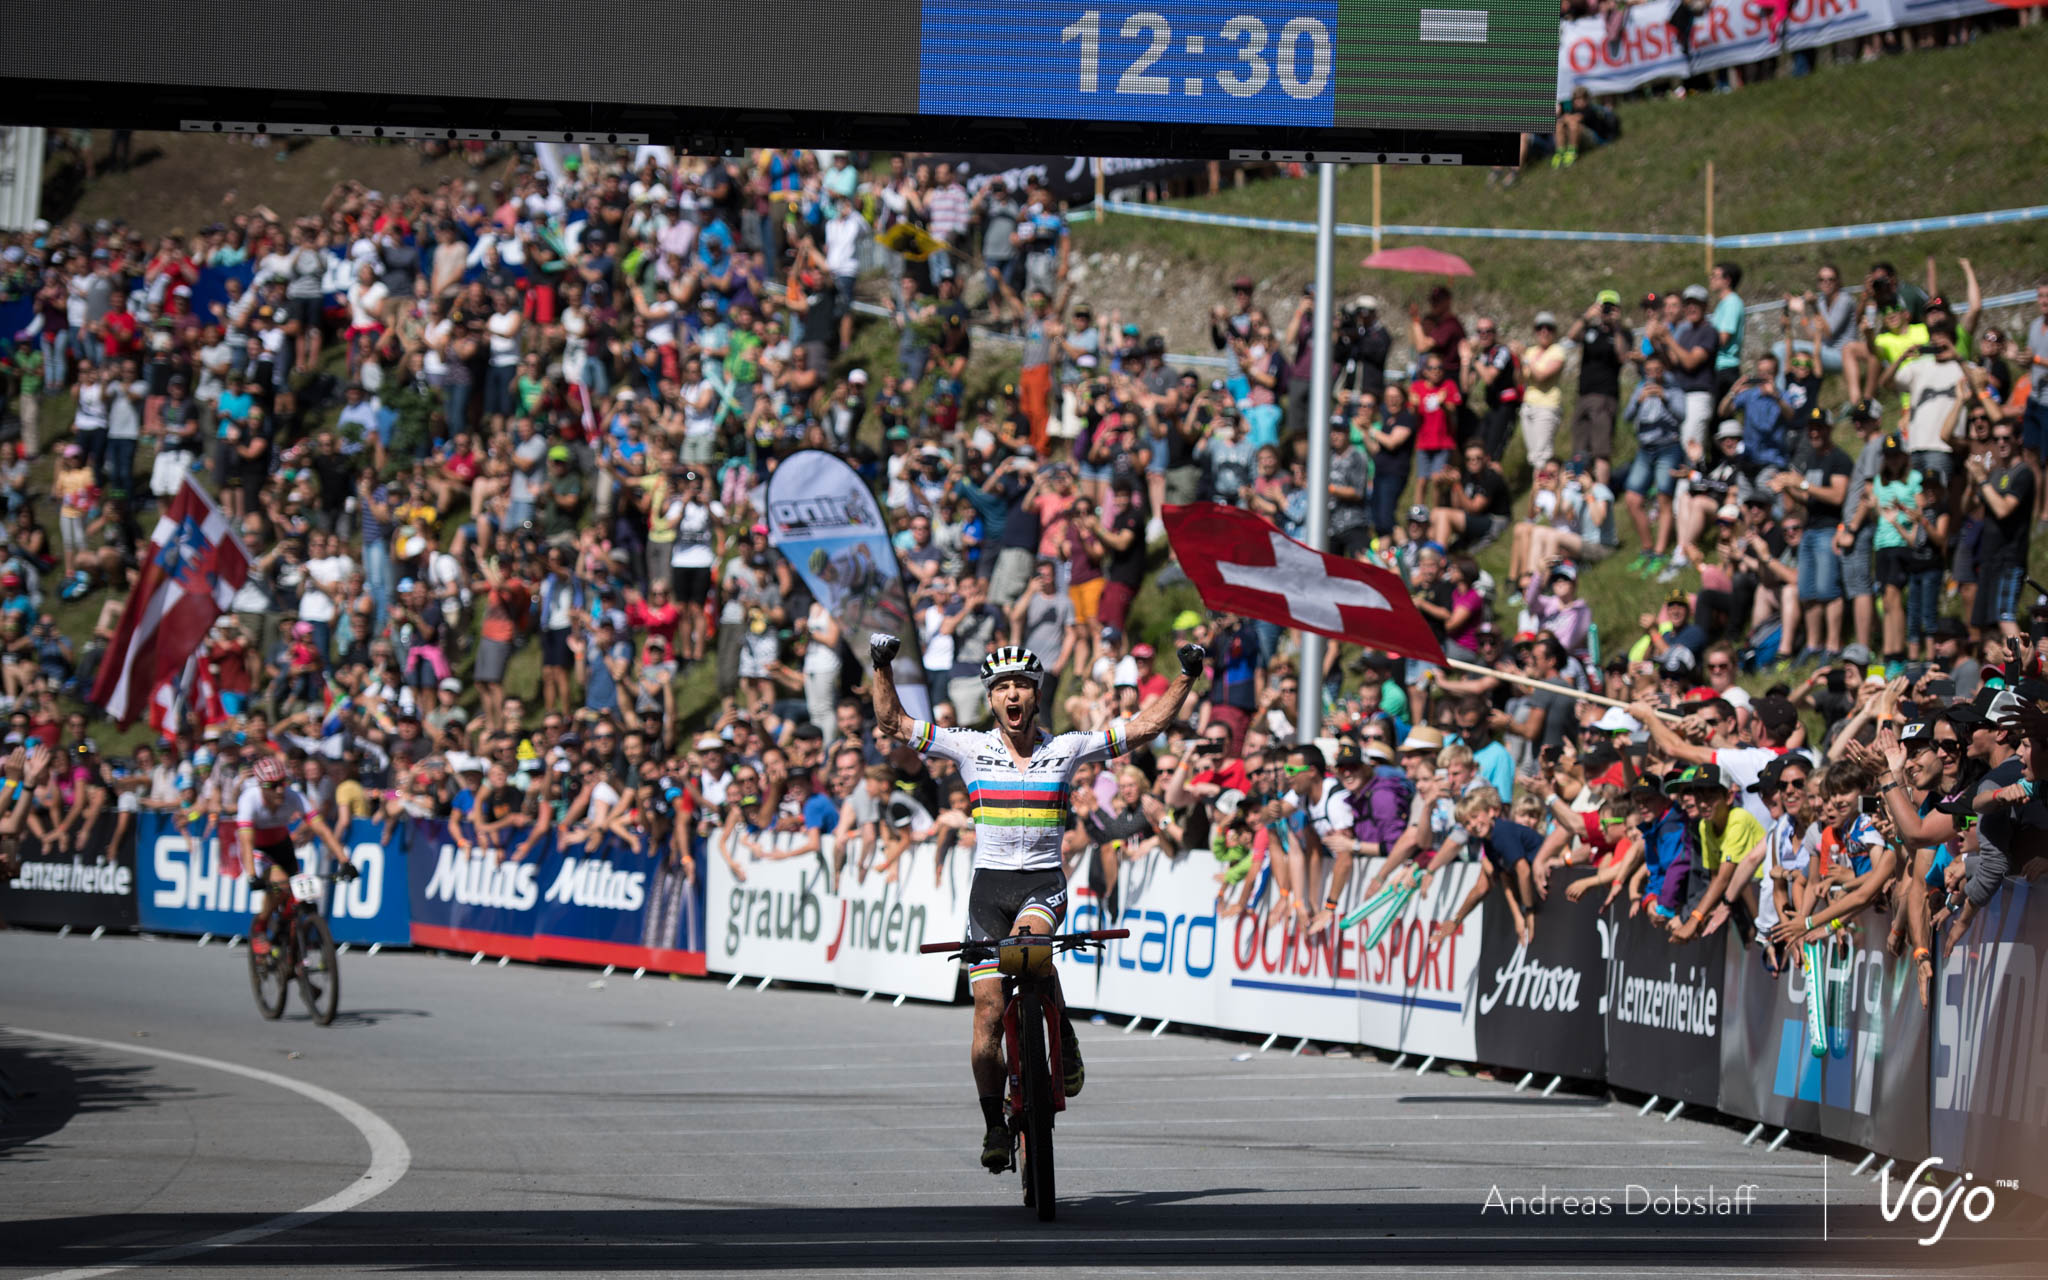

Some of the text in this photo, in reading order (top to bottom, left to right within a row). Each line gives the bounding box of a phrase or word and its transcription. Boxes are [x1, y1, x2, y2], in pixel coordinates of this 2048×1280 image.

[1062, 10, 1331, 99] 12:30
[10, 854, 132, 895] enzerheide
[425, 843, 539, 911] Mitas
[545, 857, 645, 911] Mitas
[1020, 946, 1030, 971] 1
[1479, 928, 1582, 1015] Arosa
[1617, 961, 1717, 1037] Lenzerheide
